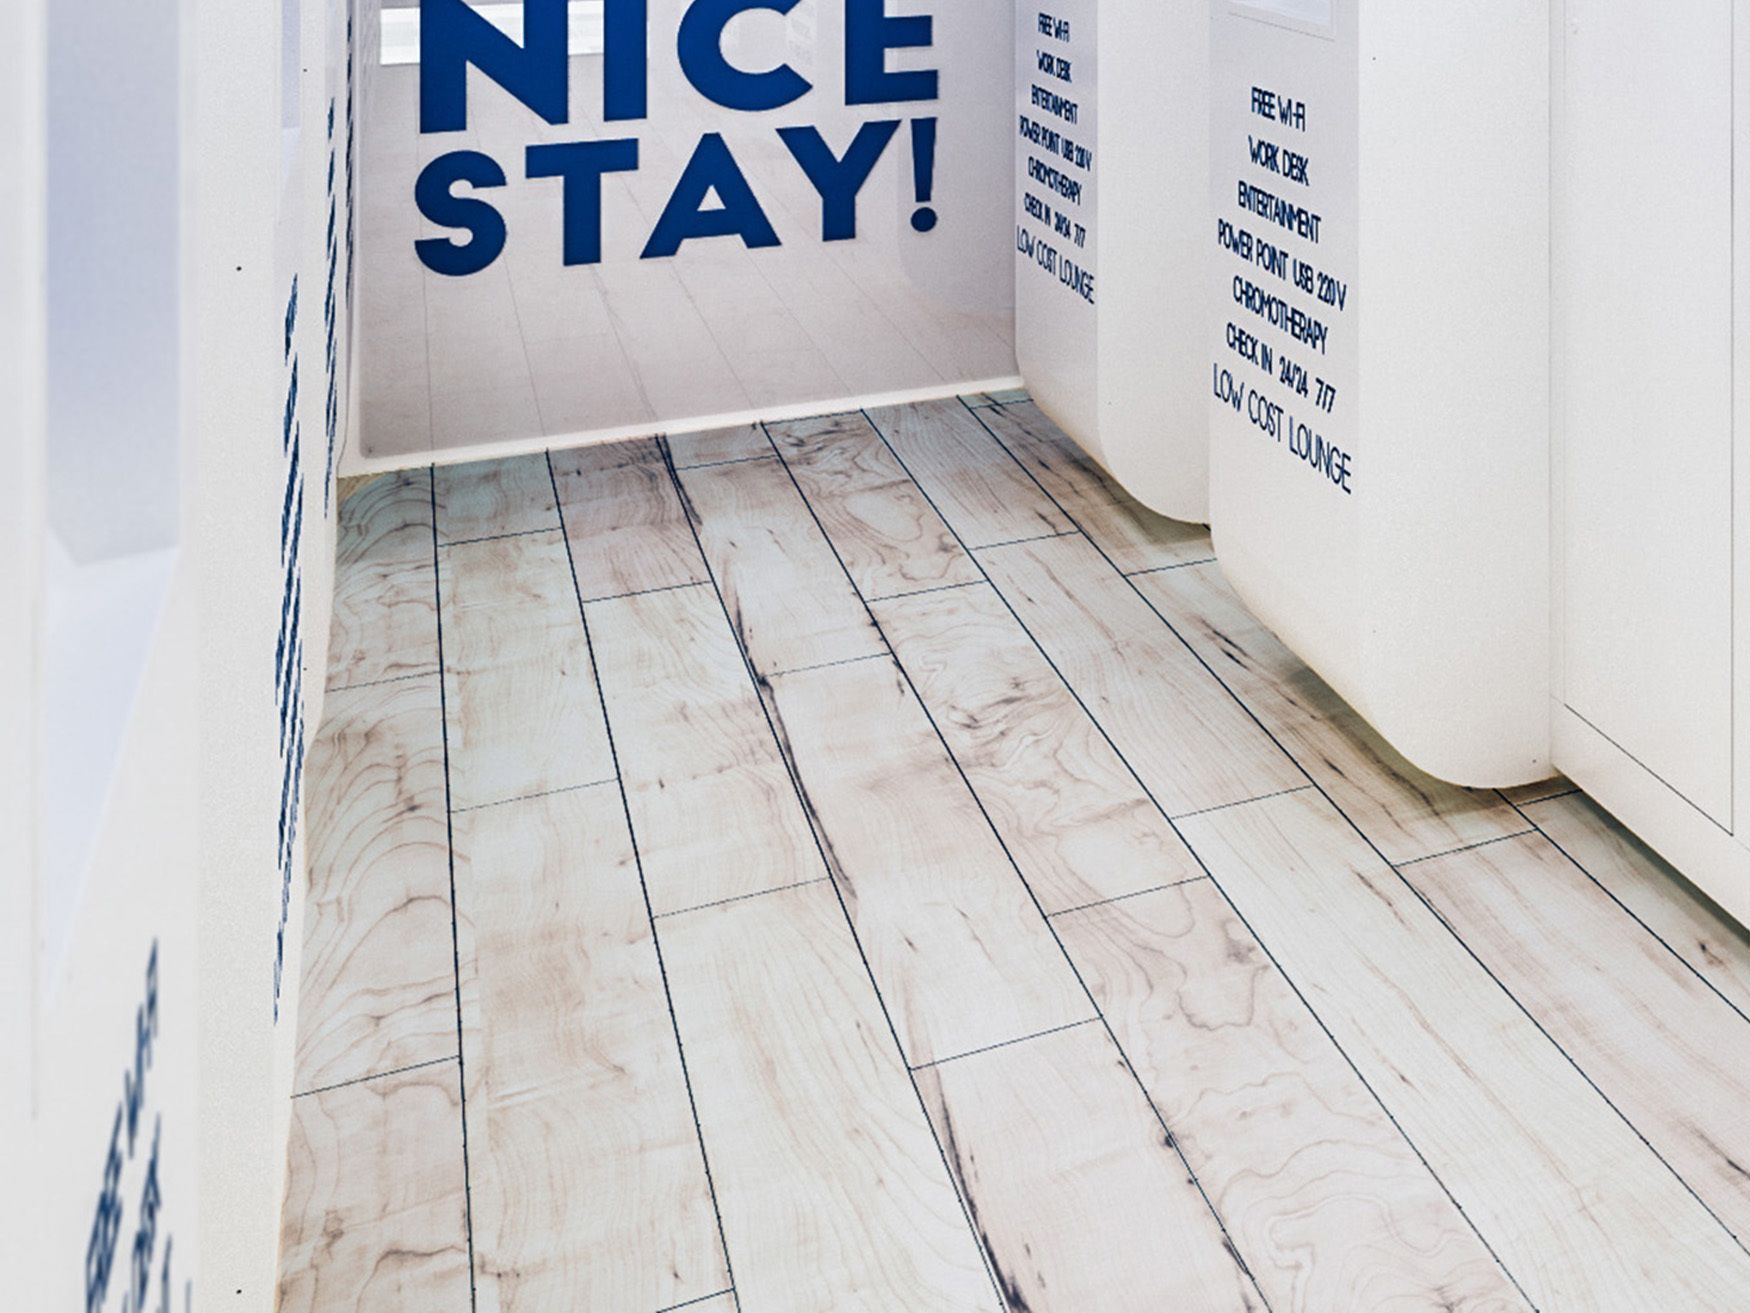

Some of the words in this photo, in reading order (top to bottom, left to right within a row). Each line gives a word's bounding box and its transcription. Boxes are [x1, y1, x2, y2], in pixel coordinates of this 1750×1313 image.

[1252, 87, 1275, 120] FREE
[1278, 96, 1305, 132] WI-FI
[415, 117, 937, 276] STAY!
[1248, 135, 1280, 173] WORK
[1283, 149, 1309, 186] DESK
[1239, 181, 1321, 243] ENTERTAINMENT
[1218, 219, 1253, 262] POWER
[1256, 238, 1288, 280] POINT
[1293, 260, 1314, 294] USB
[1233, 276, 1328, 354] CHROMOTHERAPY
[1227, 322, 1258, 365] CHECK
[1262, 344, 1272, 374] IN
[1280, 356, 1308, 397] 24/24
[1214, 364, 1244, 411] LOW
[1248, 390, 1284, 441] COST
[1290, 417, 1351, 494] LOUNGE
